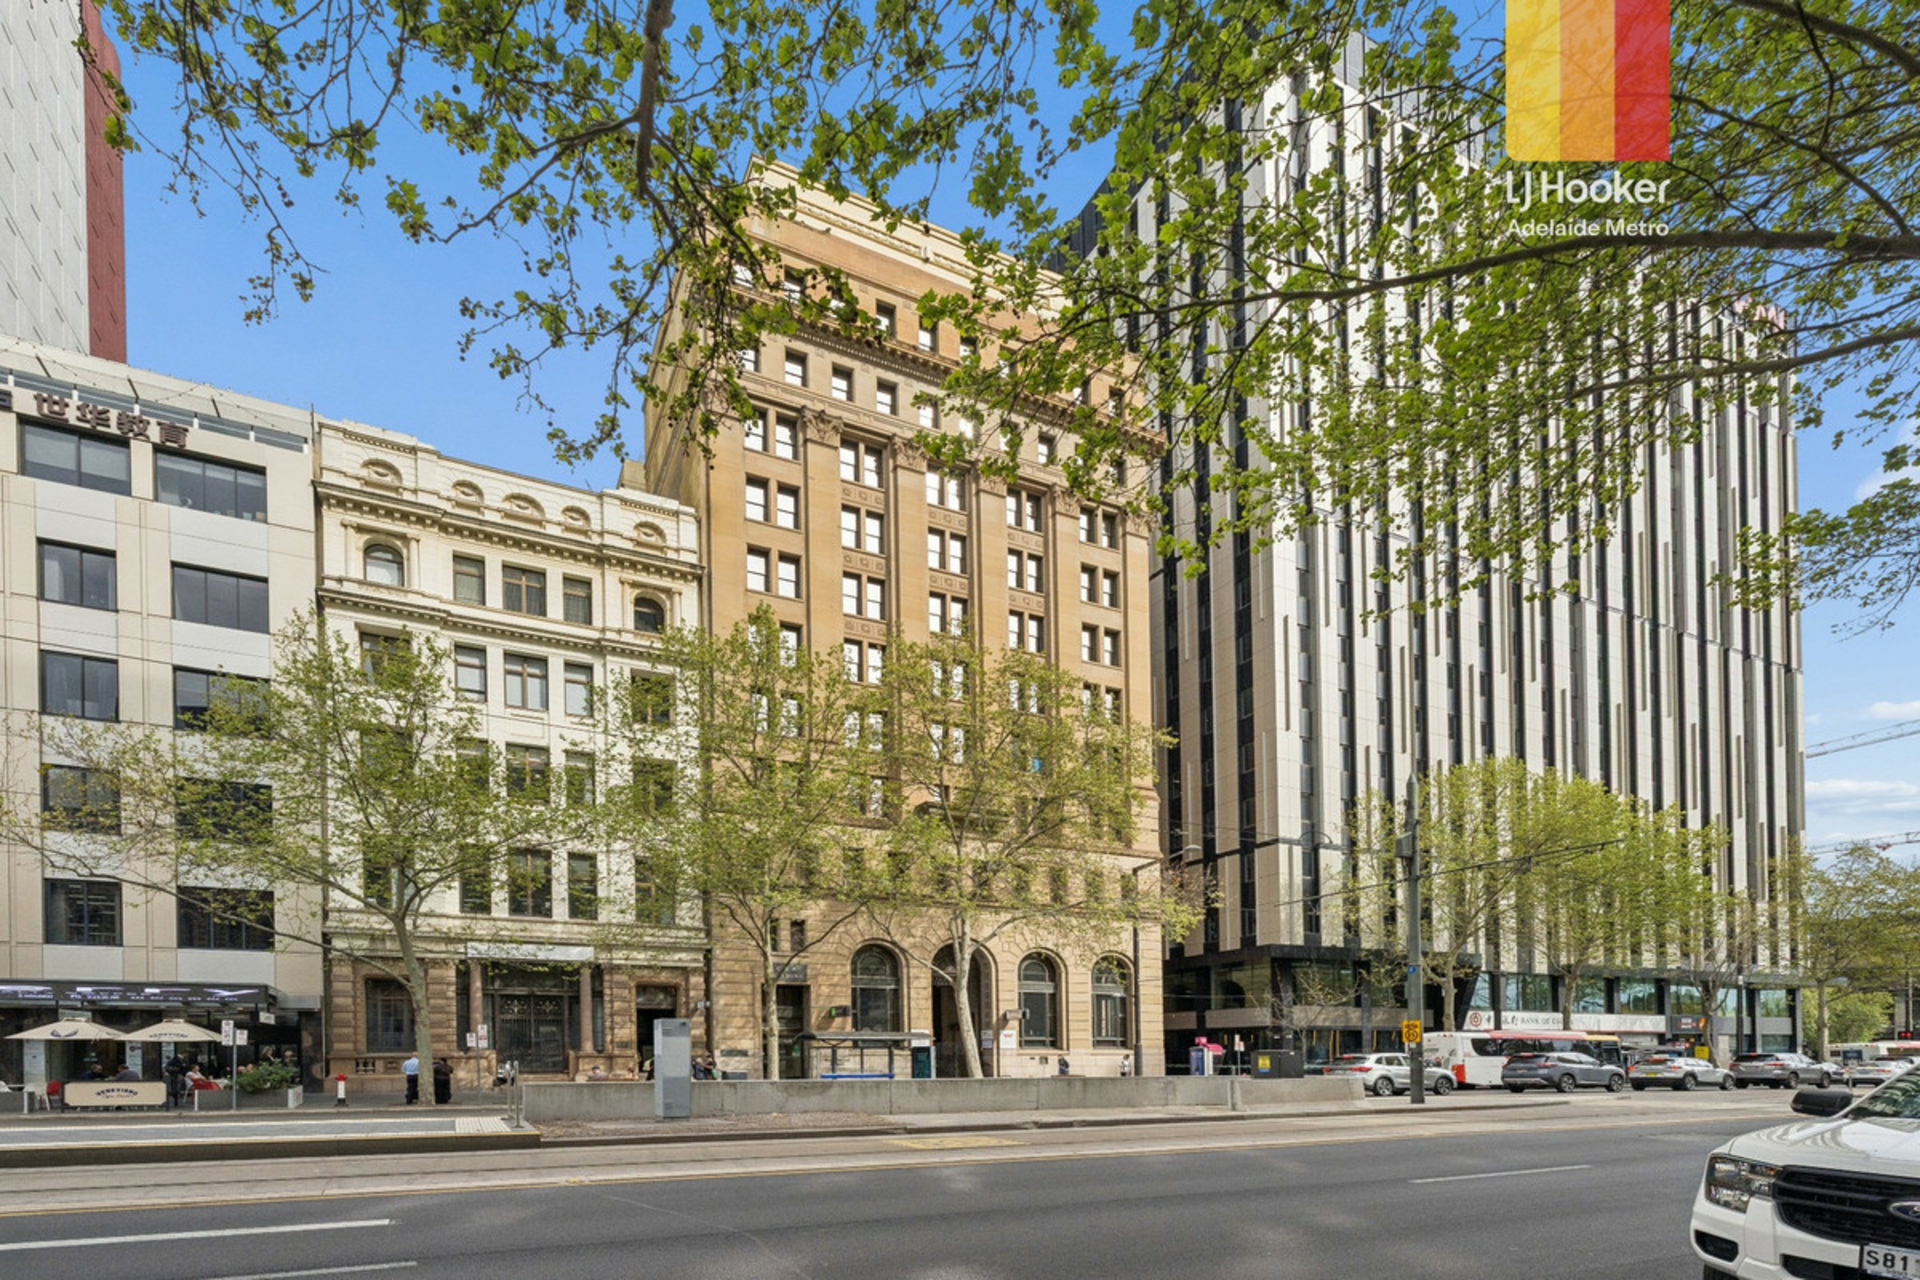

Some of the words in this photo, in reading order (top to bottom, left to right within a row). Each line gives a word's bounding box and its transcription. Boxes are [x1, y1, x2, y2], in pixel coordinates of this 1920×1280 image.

[33, 393, 189, 448] 世华教育
[1866, 1249, 1920, 1271] S81
